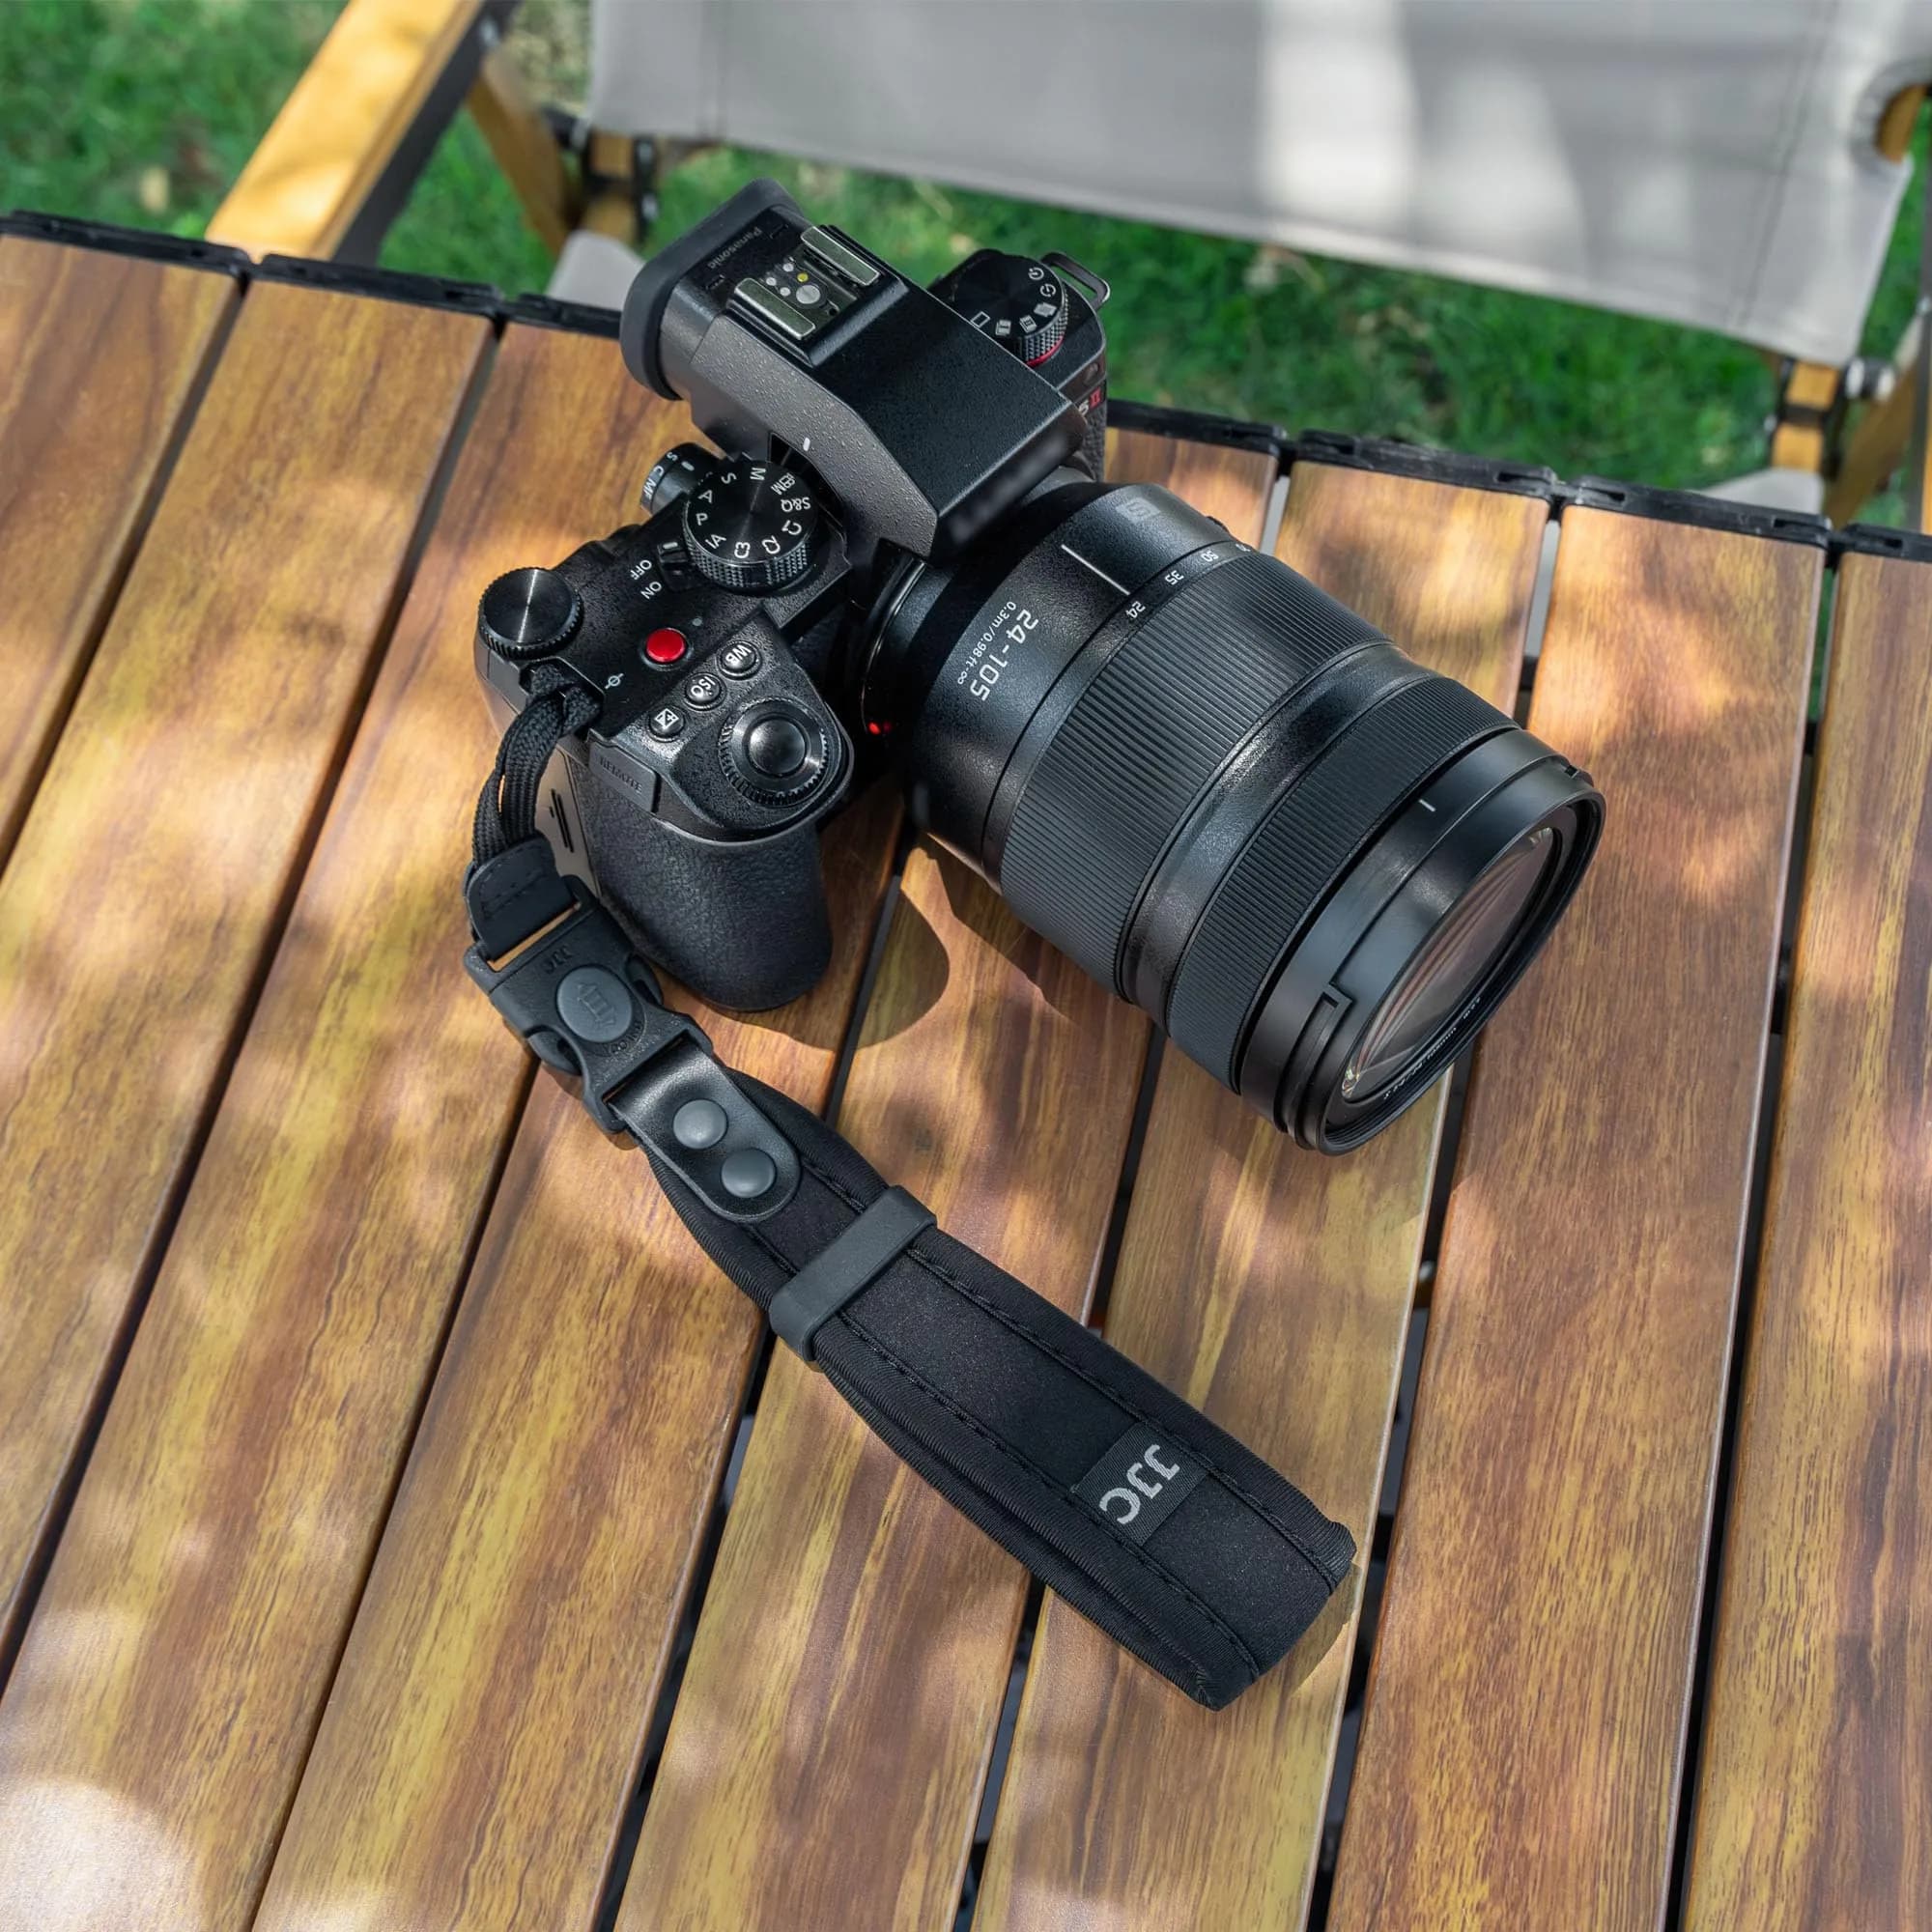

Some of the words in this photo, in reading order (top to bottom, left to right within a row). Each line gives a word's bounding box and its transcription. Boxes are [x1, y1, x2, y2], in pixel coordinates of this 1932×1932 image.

[667, 451, 678, 461] S
[653, 465, 664, 476] C
[722, 472, 737, 484] S
[751, 467, 766, 481] M
[698, 490, 713, 503] A
[696, 513, 708, 526] P
[734, 542, 751, 559] C3
[630, 559, 652, 581] OFF
[1164, 569, 1184, 586] 35
[641, 582, 662, 599] ON
[1125, 601, 1146, 618] 24
[725, 644, 752, 666] WB
[970, 610, 1038, 700] 24-105
[690, 676, 716, 697] ISO
[1098, 1443, 1180, 1524] JJC
